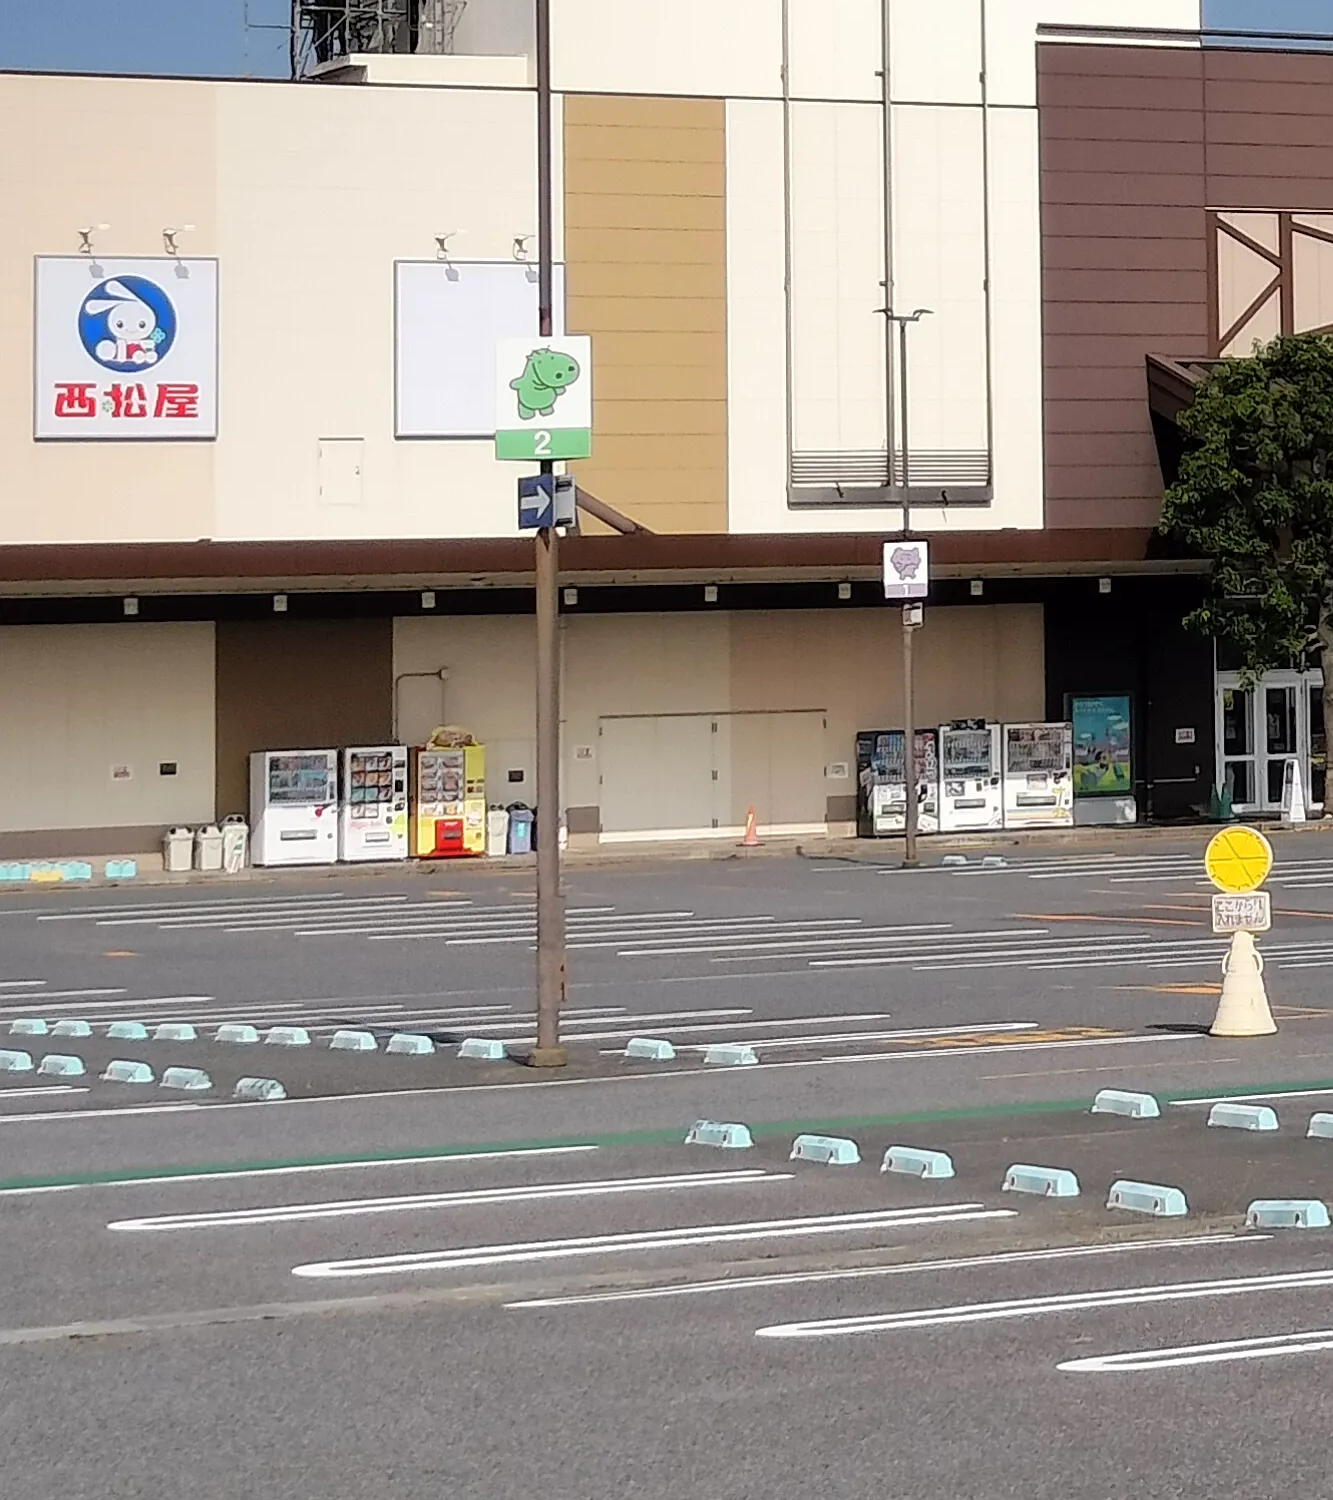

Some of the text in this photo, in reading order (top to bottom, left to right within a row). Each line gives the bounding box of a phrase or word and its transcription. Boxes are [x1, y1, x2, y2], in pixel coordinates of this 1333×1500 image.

[53, 382, 200, 419] 西松屋
[533, 429, 552, 456] 2
[902, 584, 910, 596] 1
